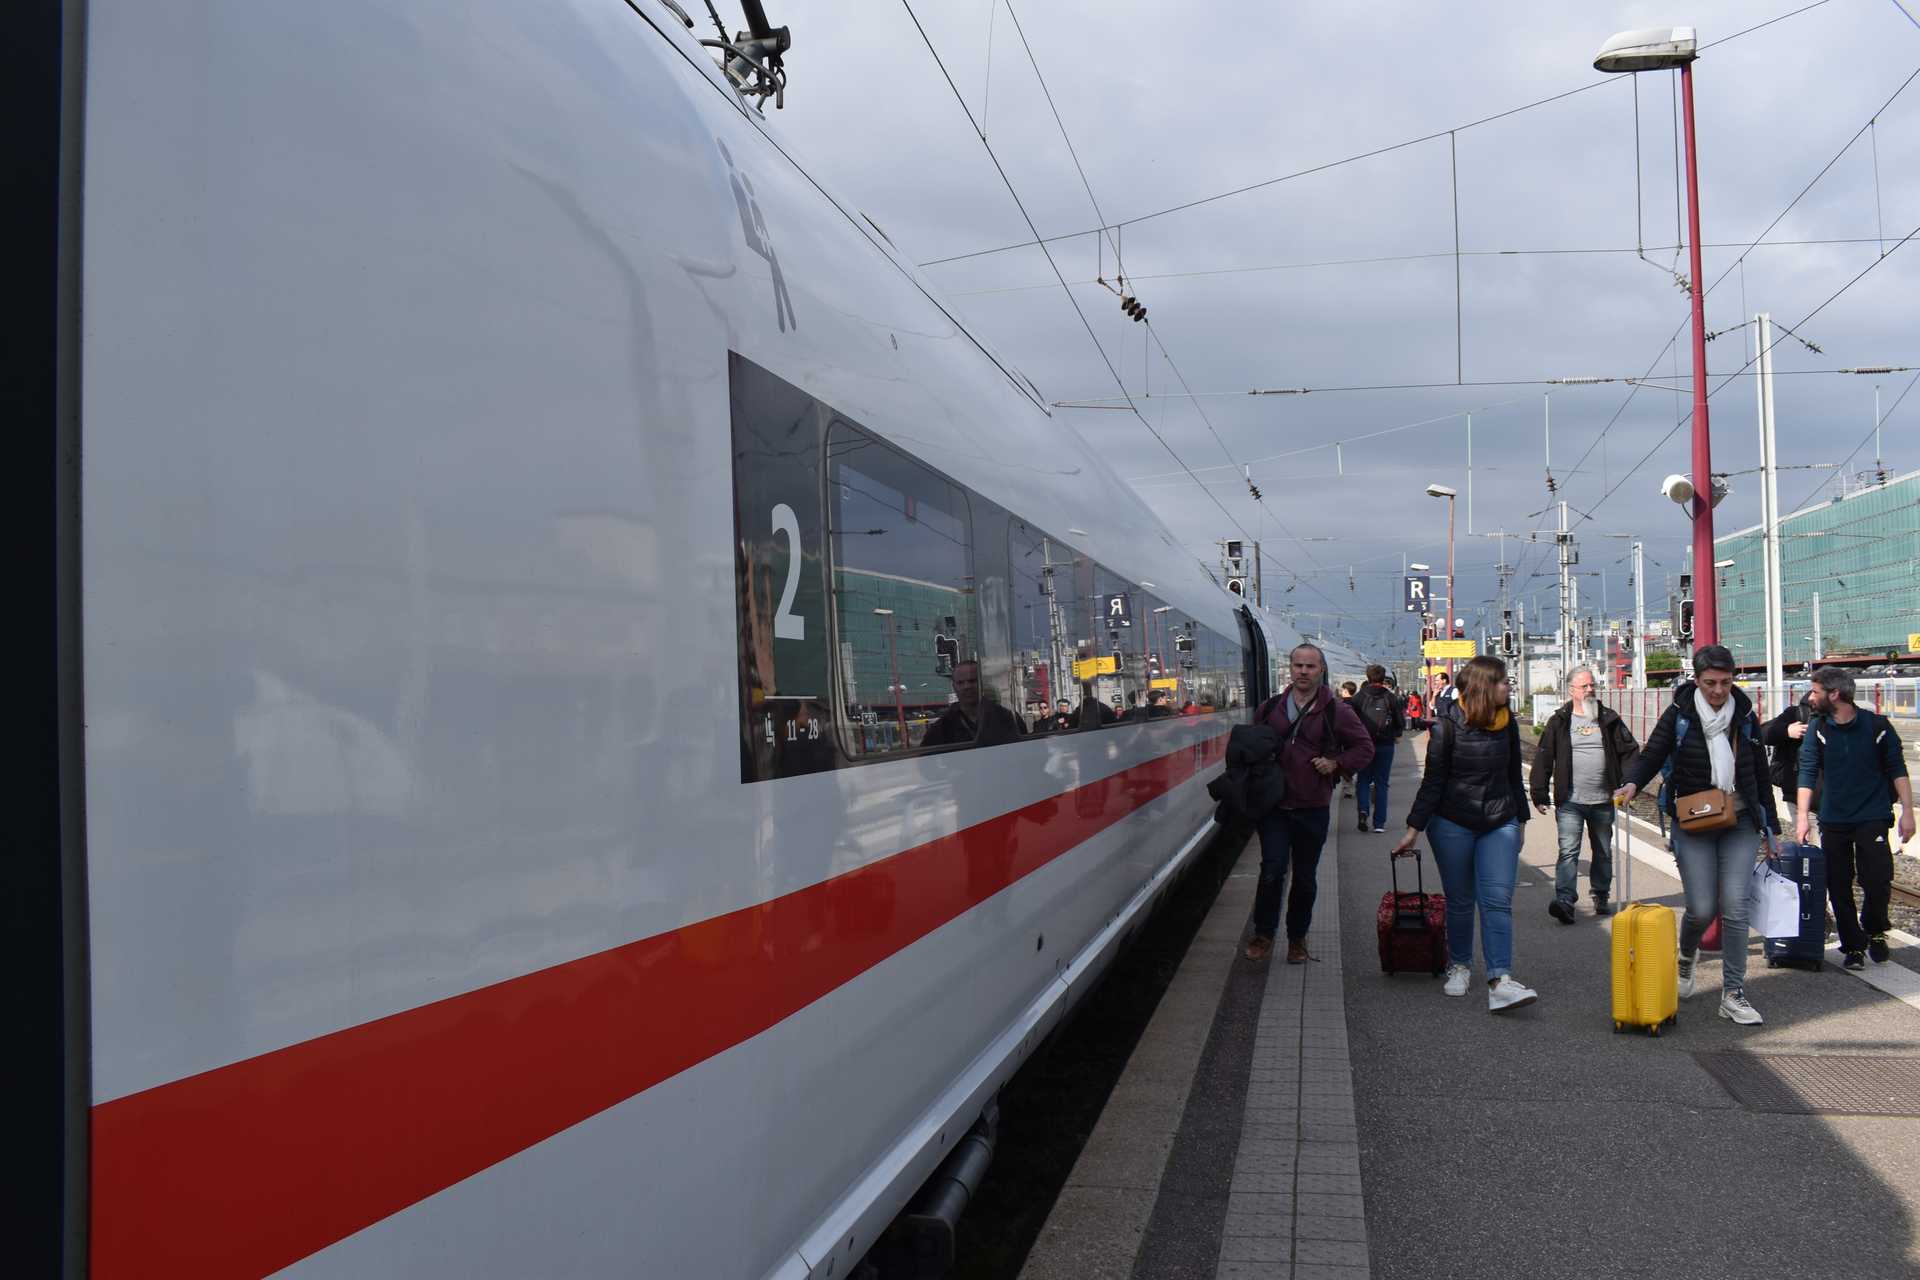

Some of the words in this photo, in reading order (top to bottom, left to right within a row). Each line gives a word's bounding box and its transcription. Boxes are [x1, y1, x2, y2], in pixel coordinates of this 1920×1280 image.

[771, 503, 805, 640] 2
[1410, 581, 1424, 599] R
[786, 719, 797, 741] 11
[807, 718, 819, 740] 28
